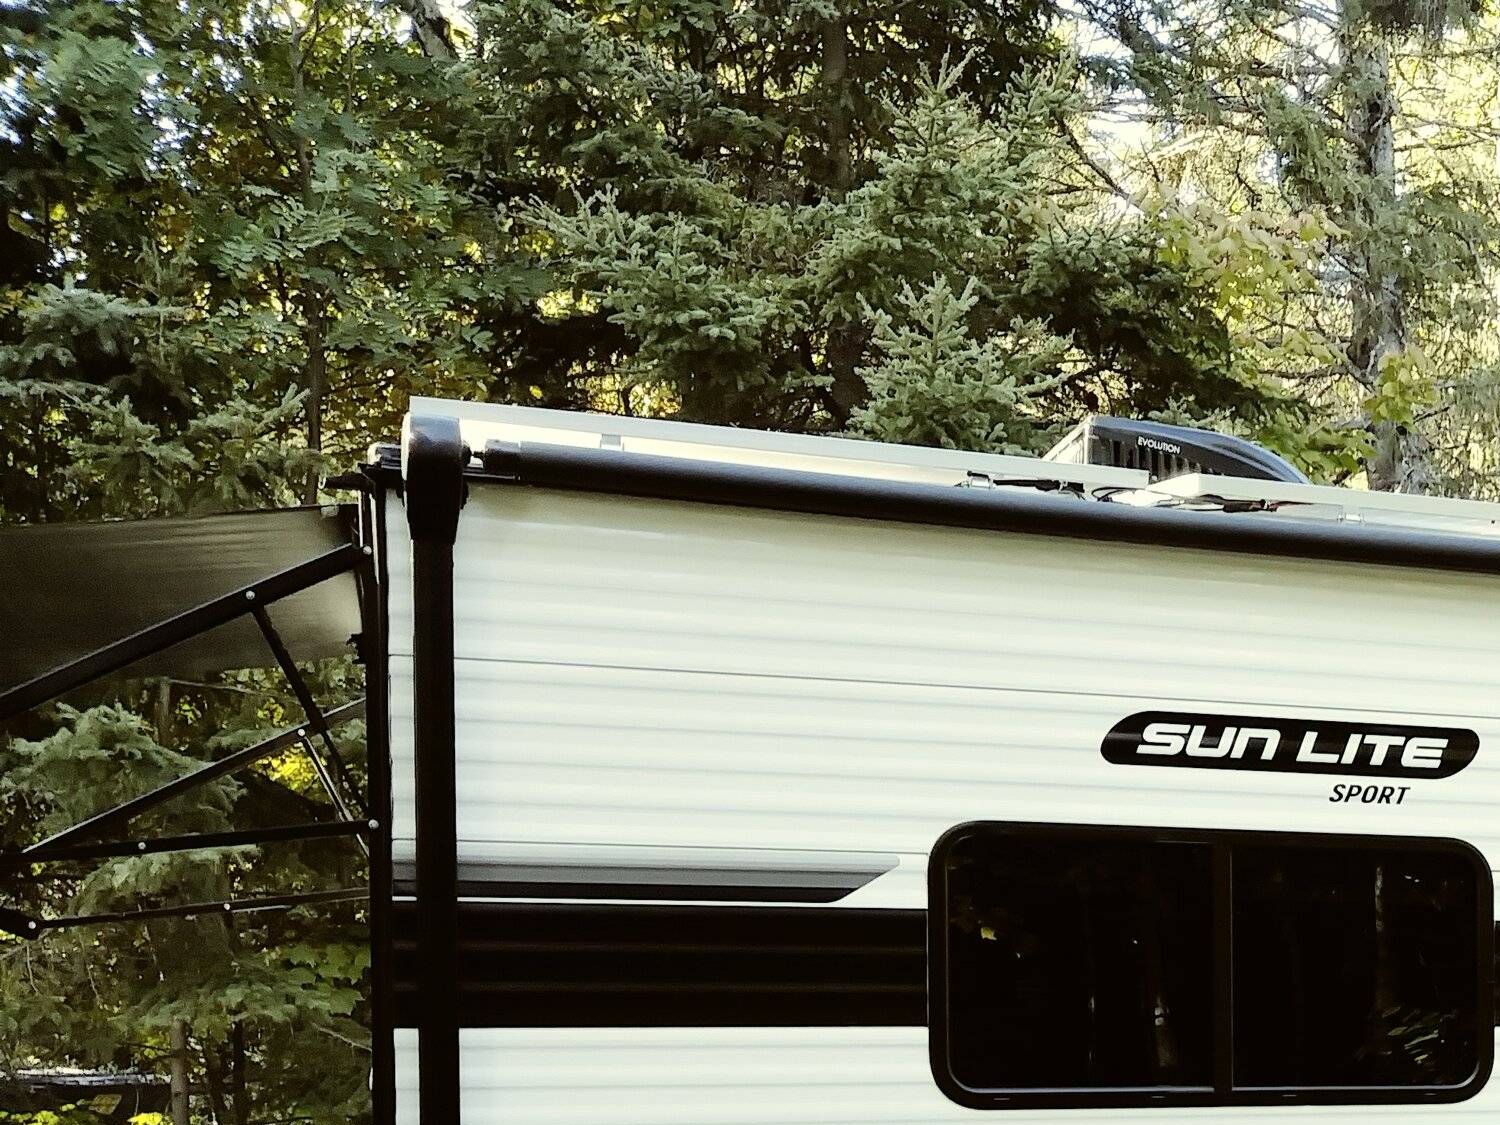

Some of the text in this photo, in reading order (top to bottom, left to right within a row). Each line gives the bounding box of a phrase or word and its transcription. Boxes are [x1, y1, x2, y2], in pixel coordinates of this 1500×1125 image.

[1137, 436, 1180, 454] EVOLUTION
[1136, 723, 1449, 769] SUN LITE
[1328, 783, 1411, 805] SPORT
